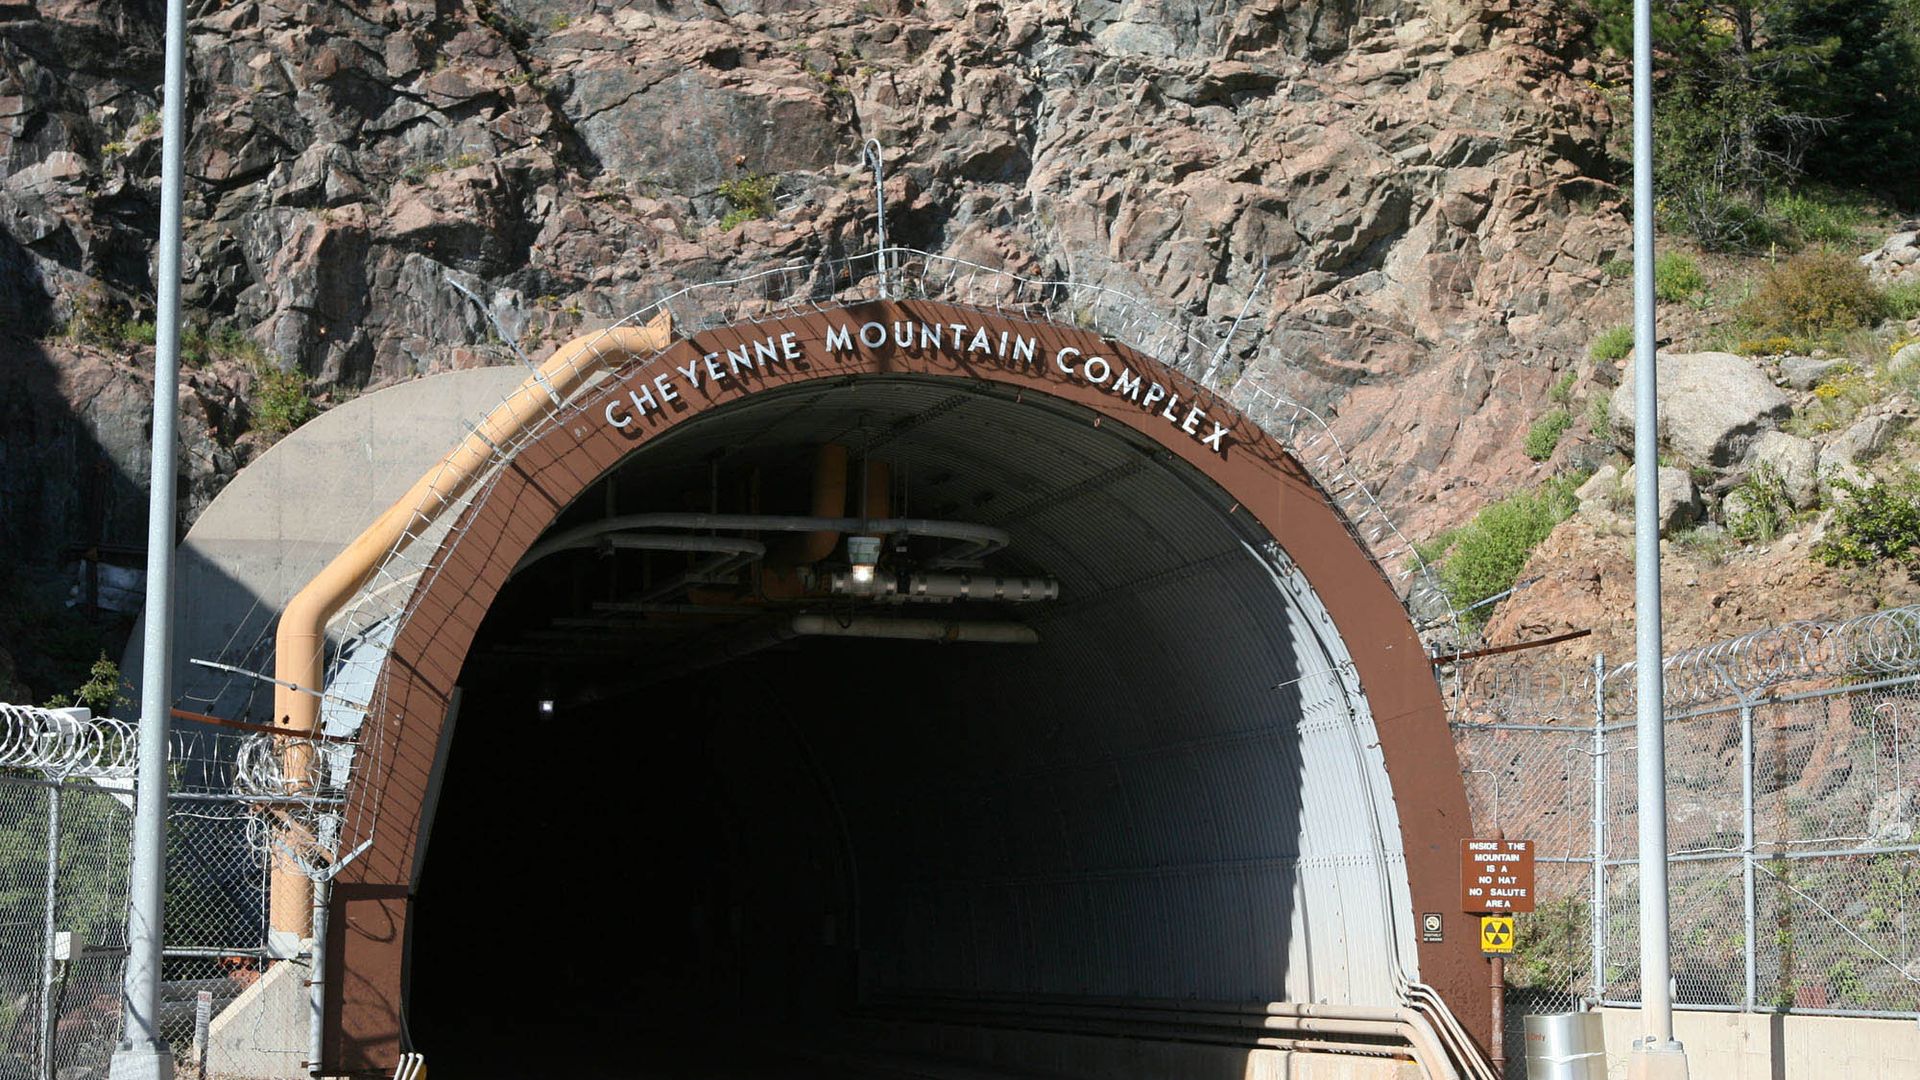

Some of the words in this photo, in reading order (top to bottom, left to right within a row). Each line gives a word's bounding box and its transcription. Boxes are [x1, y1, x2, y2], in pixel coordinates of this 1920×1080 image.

[605, 331, 800, 428] CHEYENNE
[826, 320, 1036, 363] MOUNTAIN
[1057, 346, 1230, 452] COMPLEX
[1469, 842, 1498, 850] INSIDE
[1507, 842, 1526, 850] THE
[1474, 853, 1520, 862] MOUNTAIN
[1486, 864, 1496, 873] IS
[1500, 865, 1508, 873] A
[1478, 876, 1492, 884] NO
[1498, 876, 1517, 884] HAT
[1469, 887, 1483, 896] NO
[1490, 887, 1527, 897] SALUTE
[1485, 899, 1511, 908] AREA
